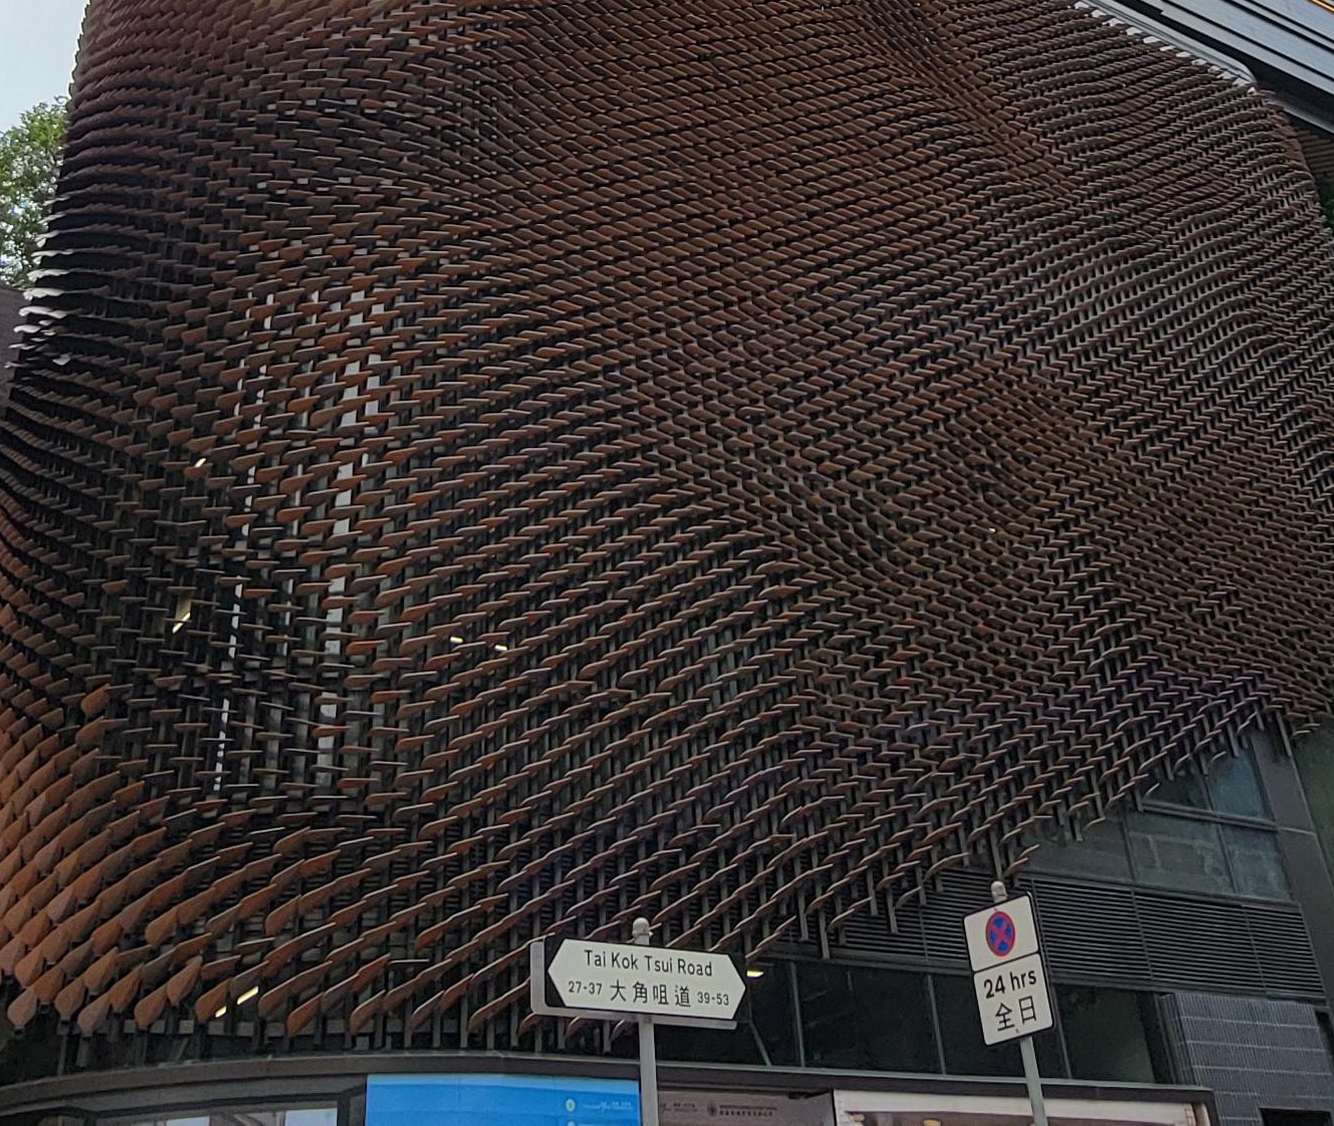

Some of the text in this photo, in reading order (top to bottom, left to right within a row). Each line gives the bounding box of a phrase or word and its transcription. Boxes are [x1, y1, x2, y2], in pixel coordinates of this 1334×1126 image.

[584, 949, 712, 977] Tai Kok Tsui Road
[568, 979, 729, 1008] 27-37 大角咀道 39-53
[983, 970, 1037, 999] 24 hrs
[995, 996, 1037, 1031] 全日
